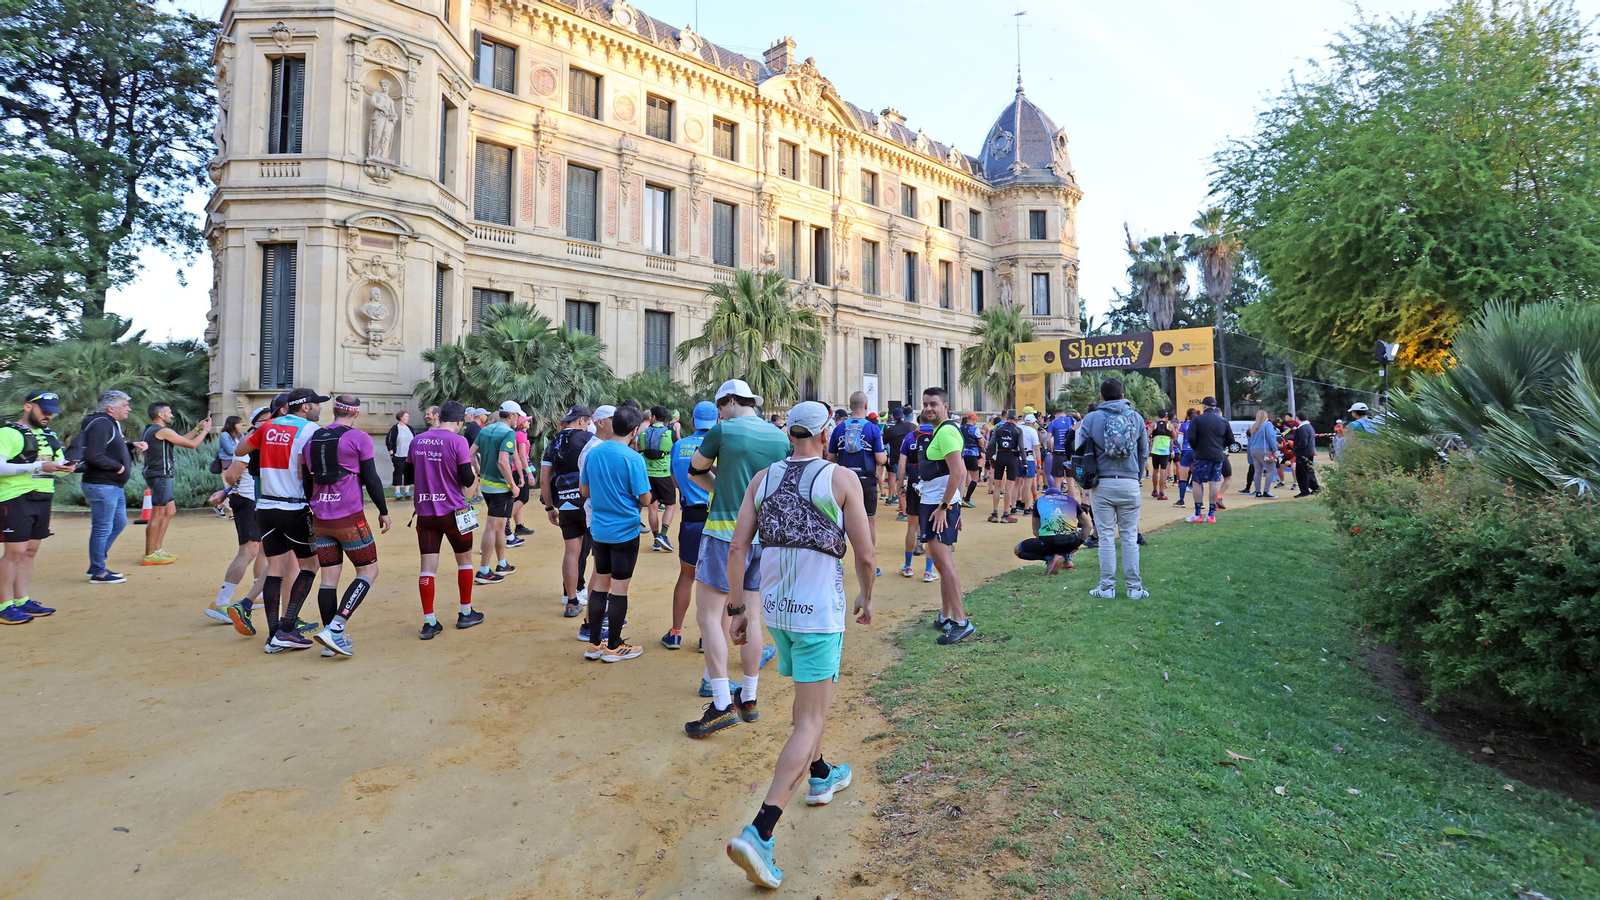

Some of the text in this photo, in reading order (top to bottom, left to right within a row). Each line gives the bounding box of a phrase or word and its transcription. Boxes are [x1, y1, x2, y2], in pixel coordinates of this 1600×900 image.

[1068, 339, 1144, 363] Sherry
[1080, 355, 1131, 368] Maratón
[266, 428, 291, 443] Cris
[418, 493, 446, 503] JEEZ
[763, 593, 814, 615] Los Olivos
